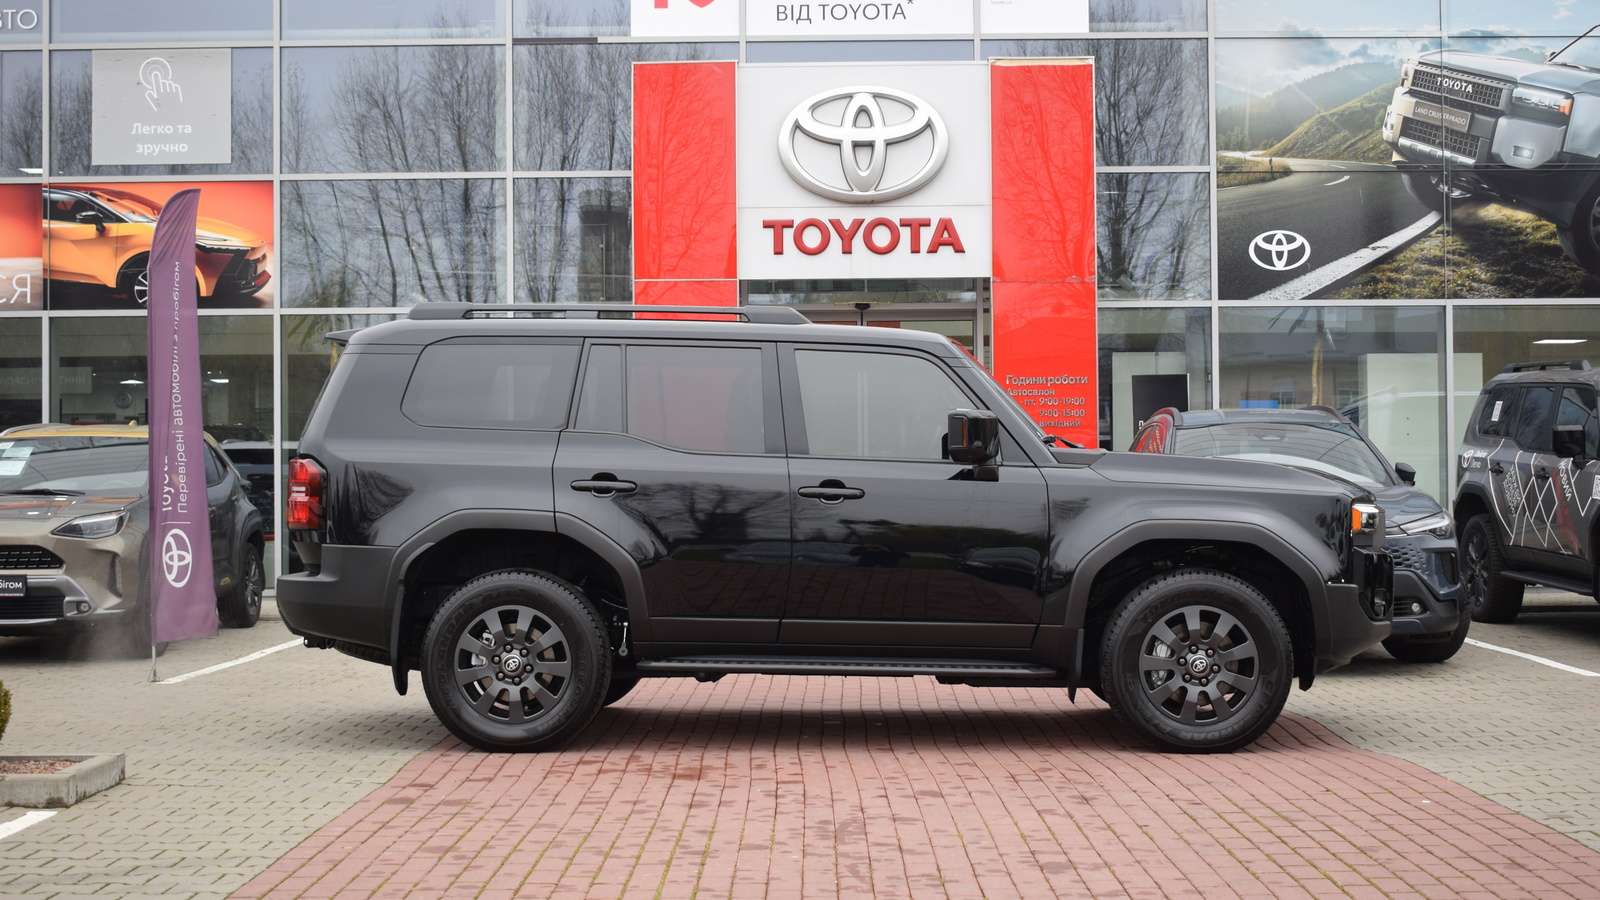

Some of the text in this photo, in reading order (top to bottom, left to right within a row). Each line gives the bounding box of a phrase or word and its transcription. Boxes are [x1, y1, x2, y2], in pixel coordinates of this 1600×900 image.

[0, 9, 38, 30] ТО
[776, 4, 812, 24] ВІД
[1437, 77, 1473, 93] TOYOTA
[1415, 107, 1428, 115] LAND
[1449, 115, 1466, 125] PRADO
[131, 123, 192, 135] Легко та
[136, 142, 188, 156] зручно
[763, 217, 965, 256] TOYOTA
[1006, 374, 1088, 387] Години роботи
[1007, 388, 1055, 396] Автосалон
[1039, 419, 1081, 428] вихідний
[172, 430, 189, 513] Перевірені
